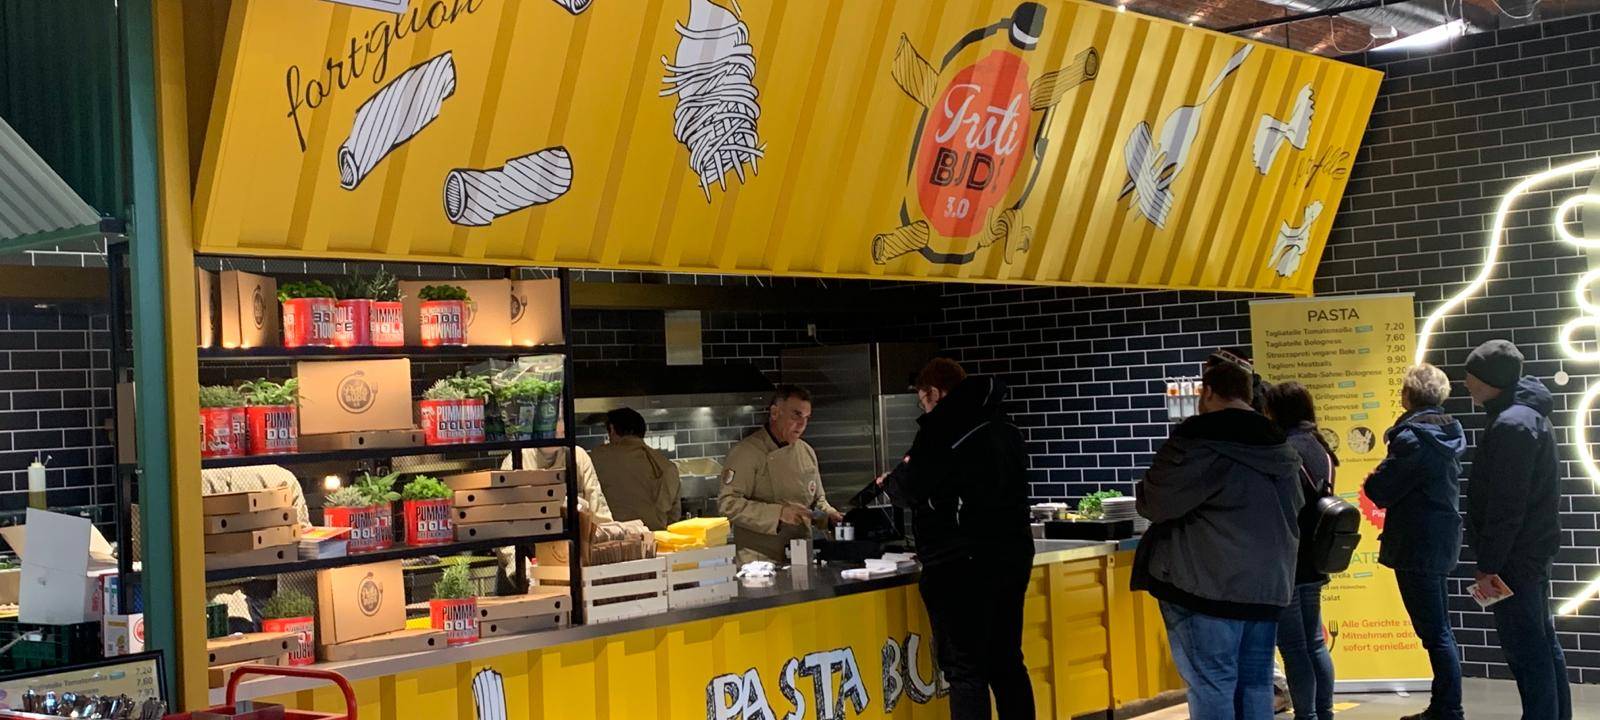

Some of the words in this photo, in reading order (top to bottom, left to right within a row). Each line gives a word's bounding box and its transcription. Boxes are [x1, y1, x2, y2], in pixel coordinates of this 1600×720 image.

[1307, 308, 1360, 322] PASTA
[1322, 594, 1341, 602] Salat
[1342, 619, 1360, 628] Alle
[1361, 618, 1400, 628] Gerichte
[1342, 630, 1393, 640] Mitnehmen
[1343, 643, 1371, 651] sofort
[1372, 641, 1418, 653] genießen!
[706, 646, 870, 720] PASTA
